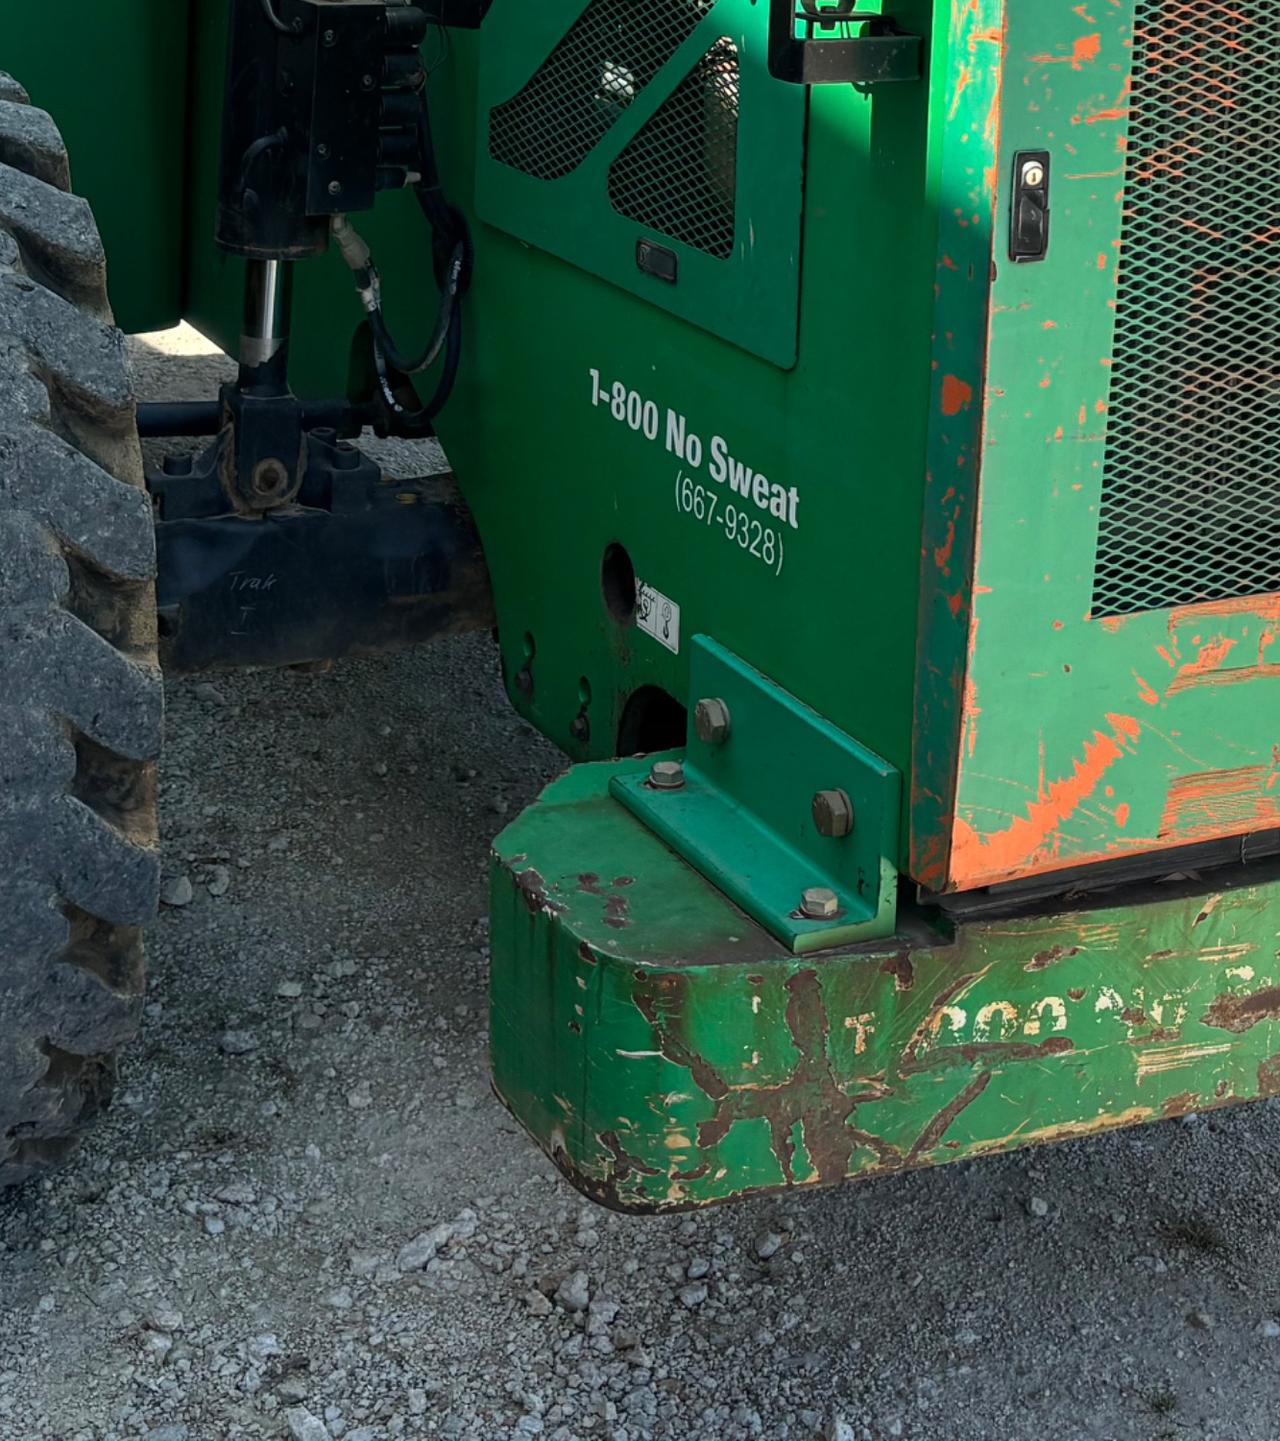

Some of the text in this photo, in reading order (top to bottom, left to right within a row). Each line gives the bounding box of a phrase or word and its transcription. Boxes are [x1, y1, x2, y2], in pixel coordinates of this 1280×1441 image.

[589, 367, 800, 529] 1-800 No Sweat
[675, 469, 784, 576] (667-9328)
